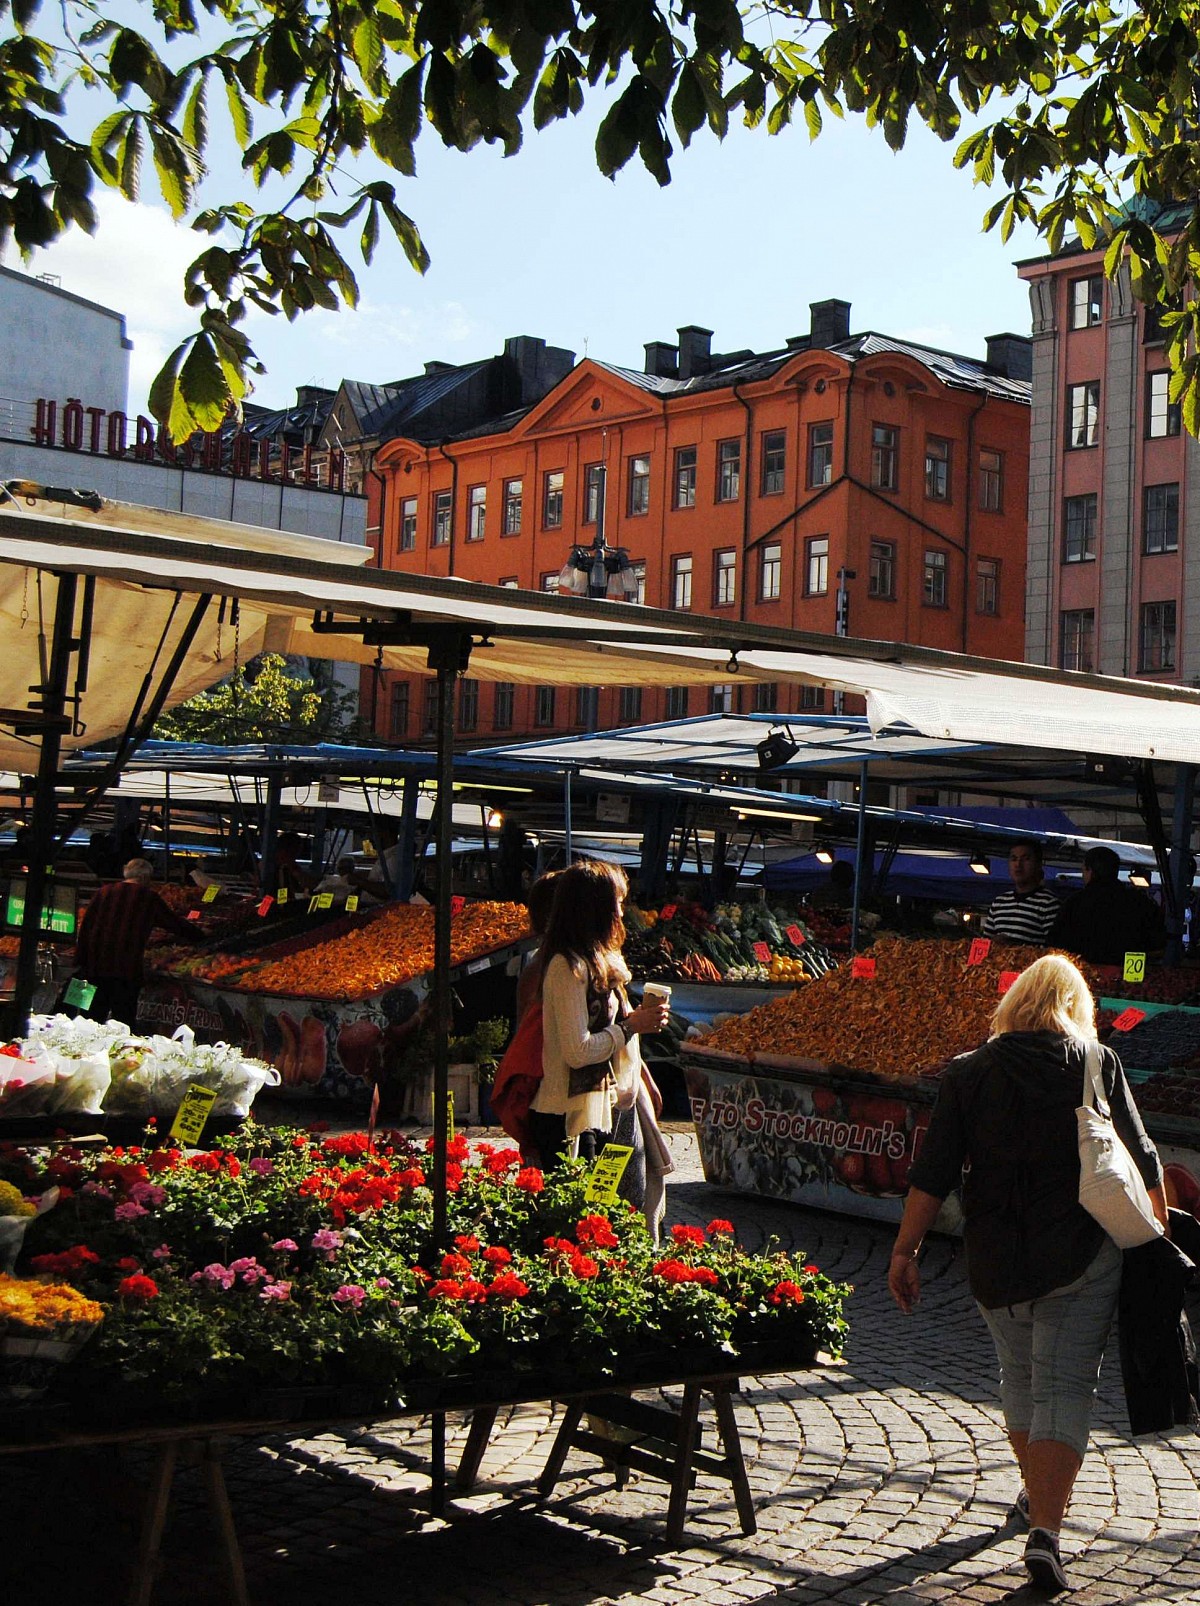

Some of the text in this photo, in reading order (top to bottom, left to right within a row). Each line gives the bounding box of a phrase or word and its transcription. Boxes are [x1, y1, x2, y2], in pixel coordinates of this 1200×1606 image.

[1126, 958, 1143, 975] 20
[1119, 1015, 1138, 1028] 40
[710, 1101, 739, 1130] TO
